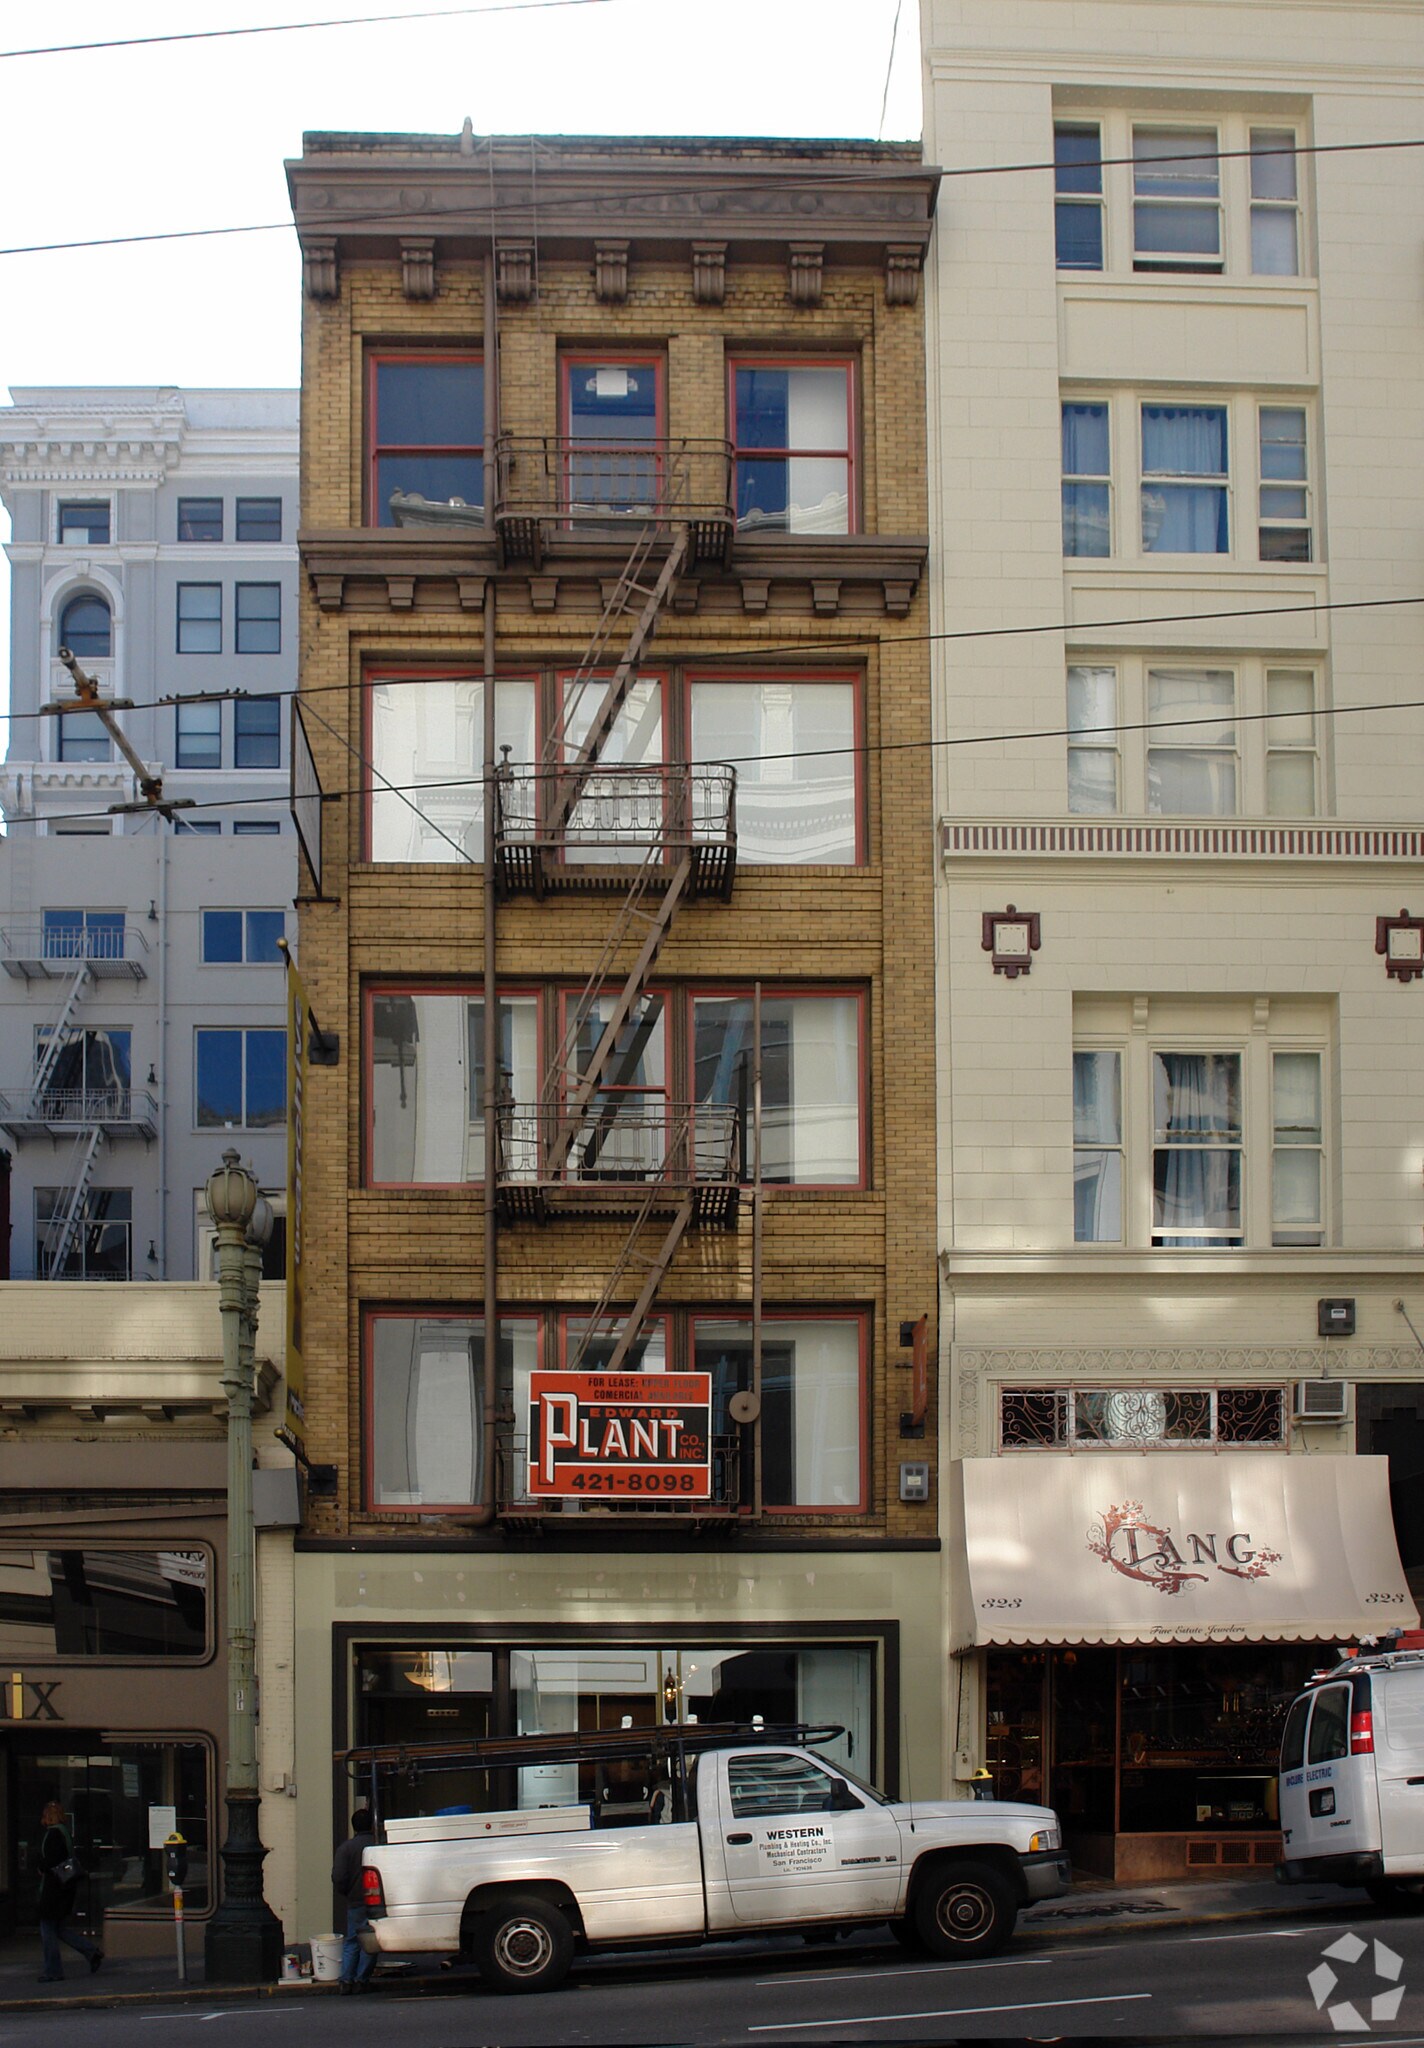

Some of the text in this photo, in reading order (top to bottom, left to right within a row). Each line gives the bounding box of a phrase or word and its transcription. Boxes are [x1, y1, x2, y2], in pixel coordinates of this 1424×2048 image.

[293, 994, 302, 1211] archive
[588, 1378, 605, 1387] FOR
[589, 1408, 679, 1418] EDWARD
[538, 1392, 684, 1485] PLANT
[679, 1448, 705, 1459] INC.
[571, 1473, 695, 1491] 421-8098
[1122, 1526, 1257, 1567] LANG
[980, 1597, 1023, 1609] 323
[1364, 1592, 1406, 1604] 323
[1148, 1624, 1246, 1637] Fine Estate Jewelers
[1306, 1766, 1332, 1782] ELECTRIC
[766, 1827, 824, 1841] WESTERN
[759, 1841, 782, 1851] Plumbing
[790, 1840, 810, 1849] Heating
[766, 1847, 827, 1858] Mechanical Contractors
[772, 1856, 822, 1867] San Francisco
